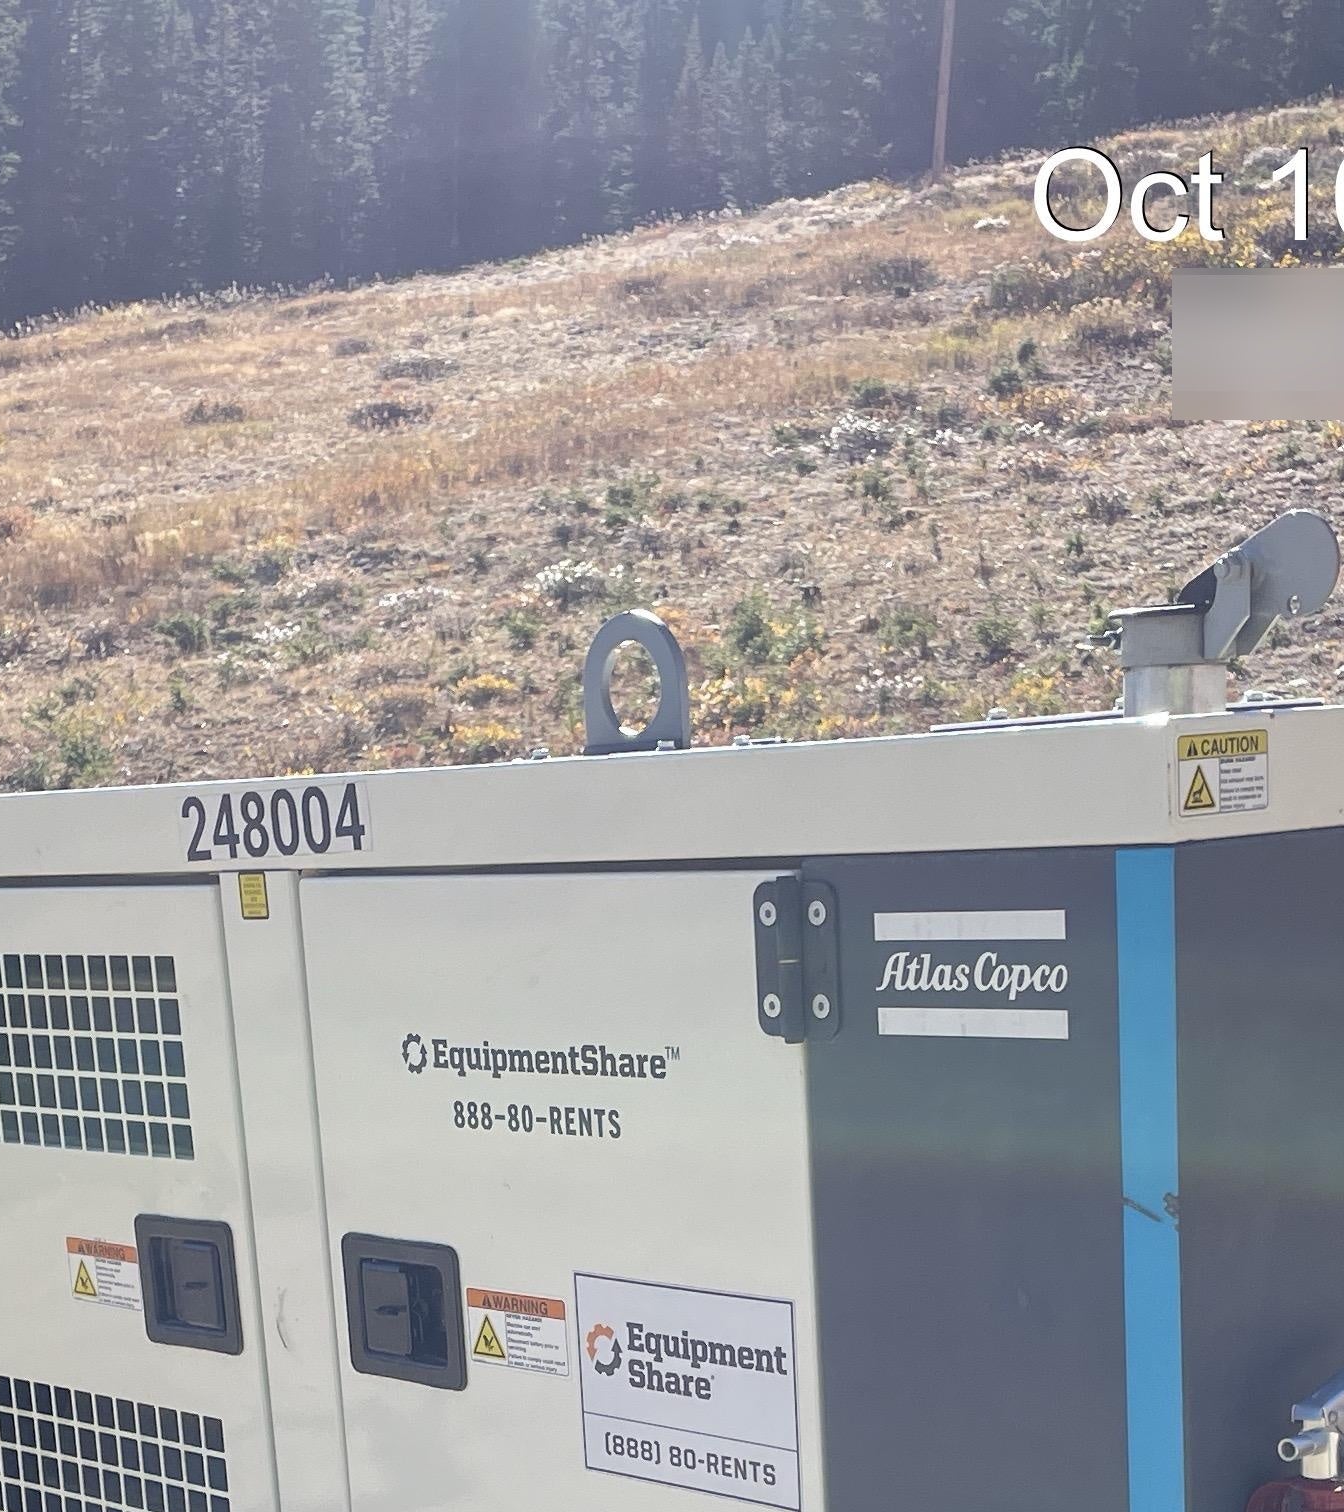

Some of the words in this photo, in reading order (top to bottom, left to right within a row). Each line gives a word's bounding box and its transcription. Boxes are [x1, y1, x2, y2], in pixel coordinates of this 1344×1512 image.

[1200, 736, 1259, 756] CAUTION
[181, 783, 365, 862] 248004
[875, 951, 970, 992] Atlas
[973, 951, 1068, 1001] Copco
[453, 1100, 621, 1139] 888-80-RENTS
[492, 1295, 548, 1315] WARNING
[626, 1321, 788, 1376] Equipment
[604, 1431, 661, 1465] (888)
[669, 1445, 777, 1486] 80-RENTS
